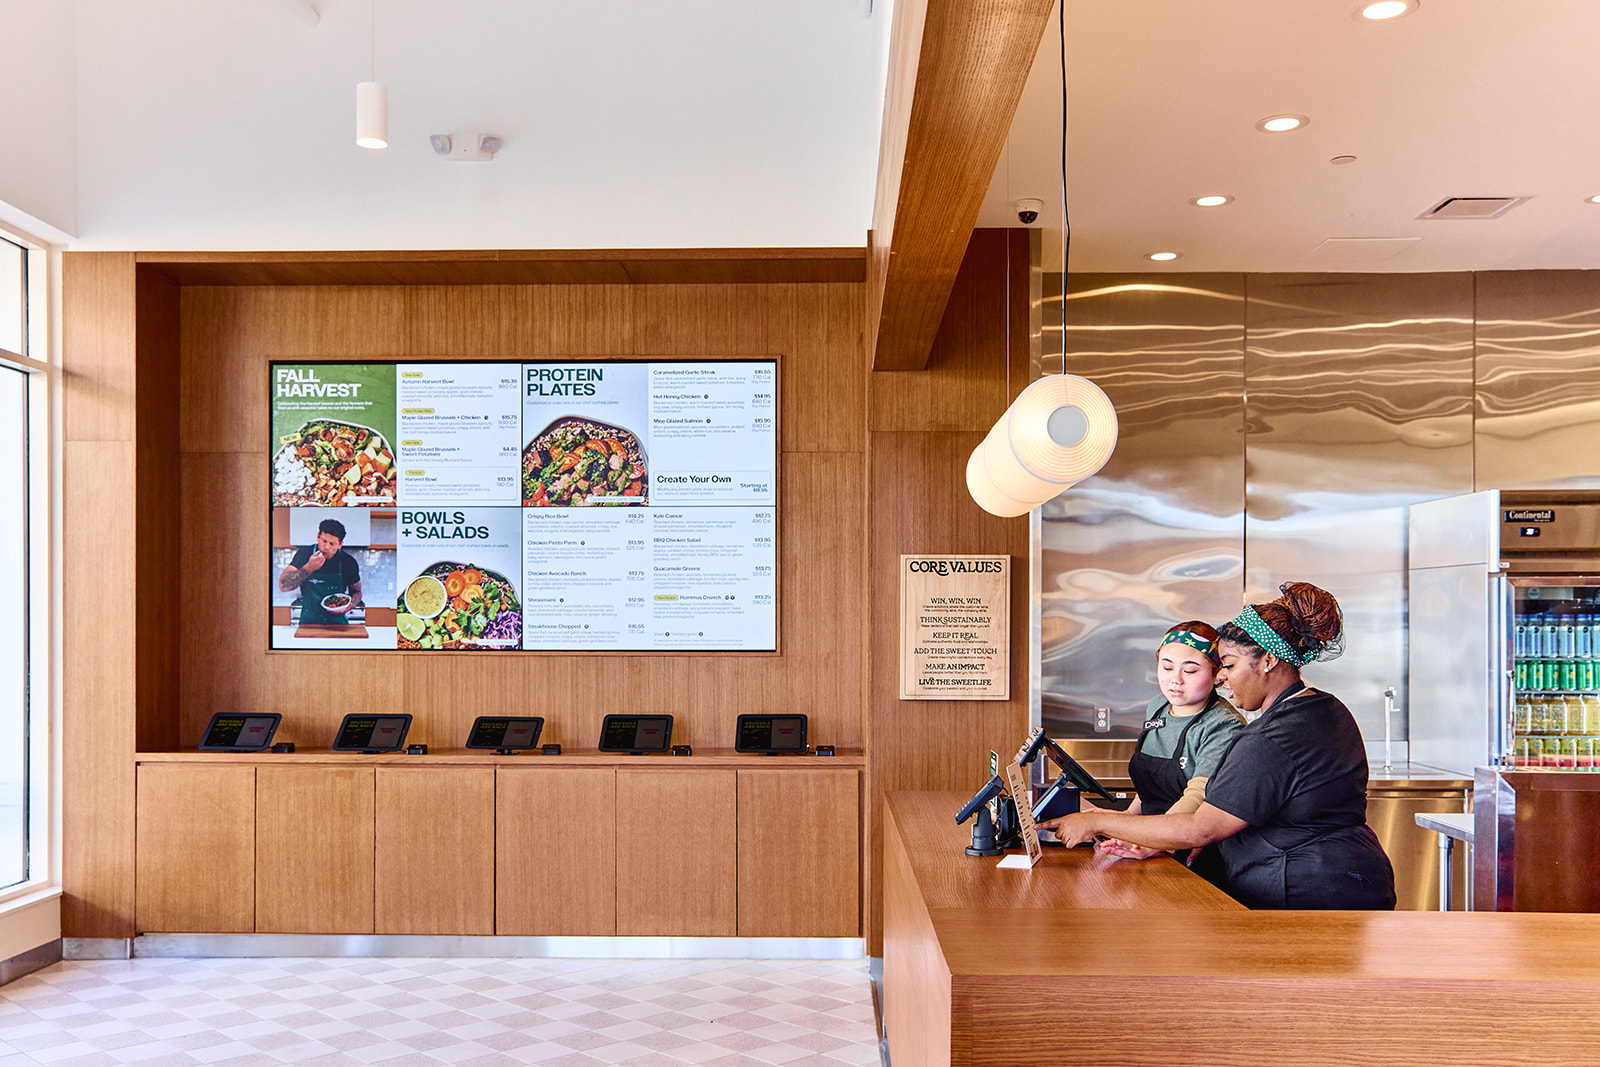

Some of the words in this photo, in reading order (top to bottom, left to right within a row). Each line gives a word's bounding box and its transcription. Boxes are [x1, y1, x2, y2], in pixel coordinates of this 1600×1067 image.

[276, 369, 320, 383] FALL
[527, 368, 603, 381] PROTEIN
[276, 383, 362, 397] HARVEST
[527, 383, 596, 396] PLATES
[283, 434, 298, 442] NEW
[656, 475, 688, 484] Create
[689, 475, 710, 484] Your
[711, 475, 732, 484] Own
[401, 511, 465, 524] BOWLS
[1509, 510, 1551, 519] Continental
[402, 528, 412, 537] +
[416, 526, 489, 539] SALADS
[910, 561, 949, 576] CORE
[949, 561, 1002, 573] VALUES
[920, 616, 947, 625] THINK
[960, 632, 979, 640] REAL
[918, 676, 936, 685] LIVE
